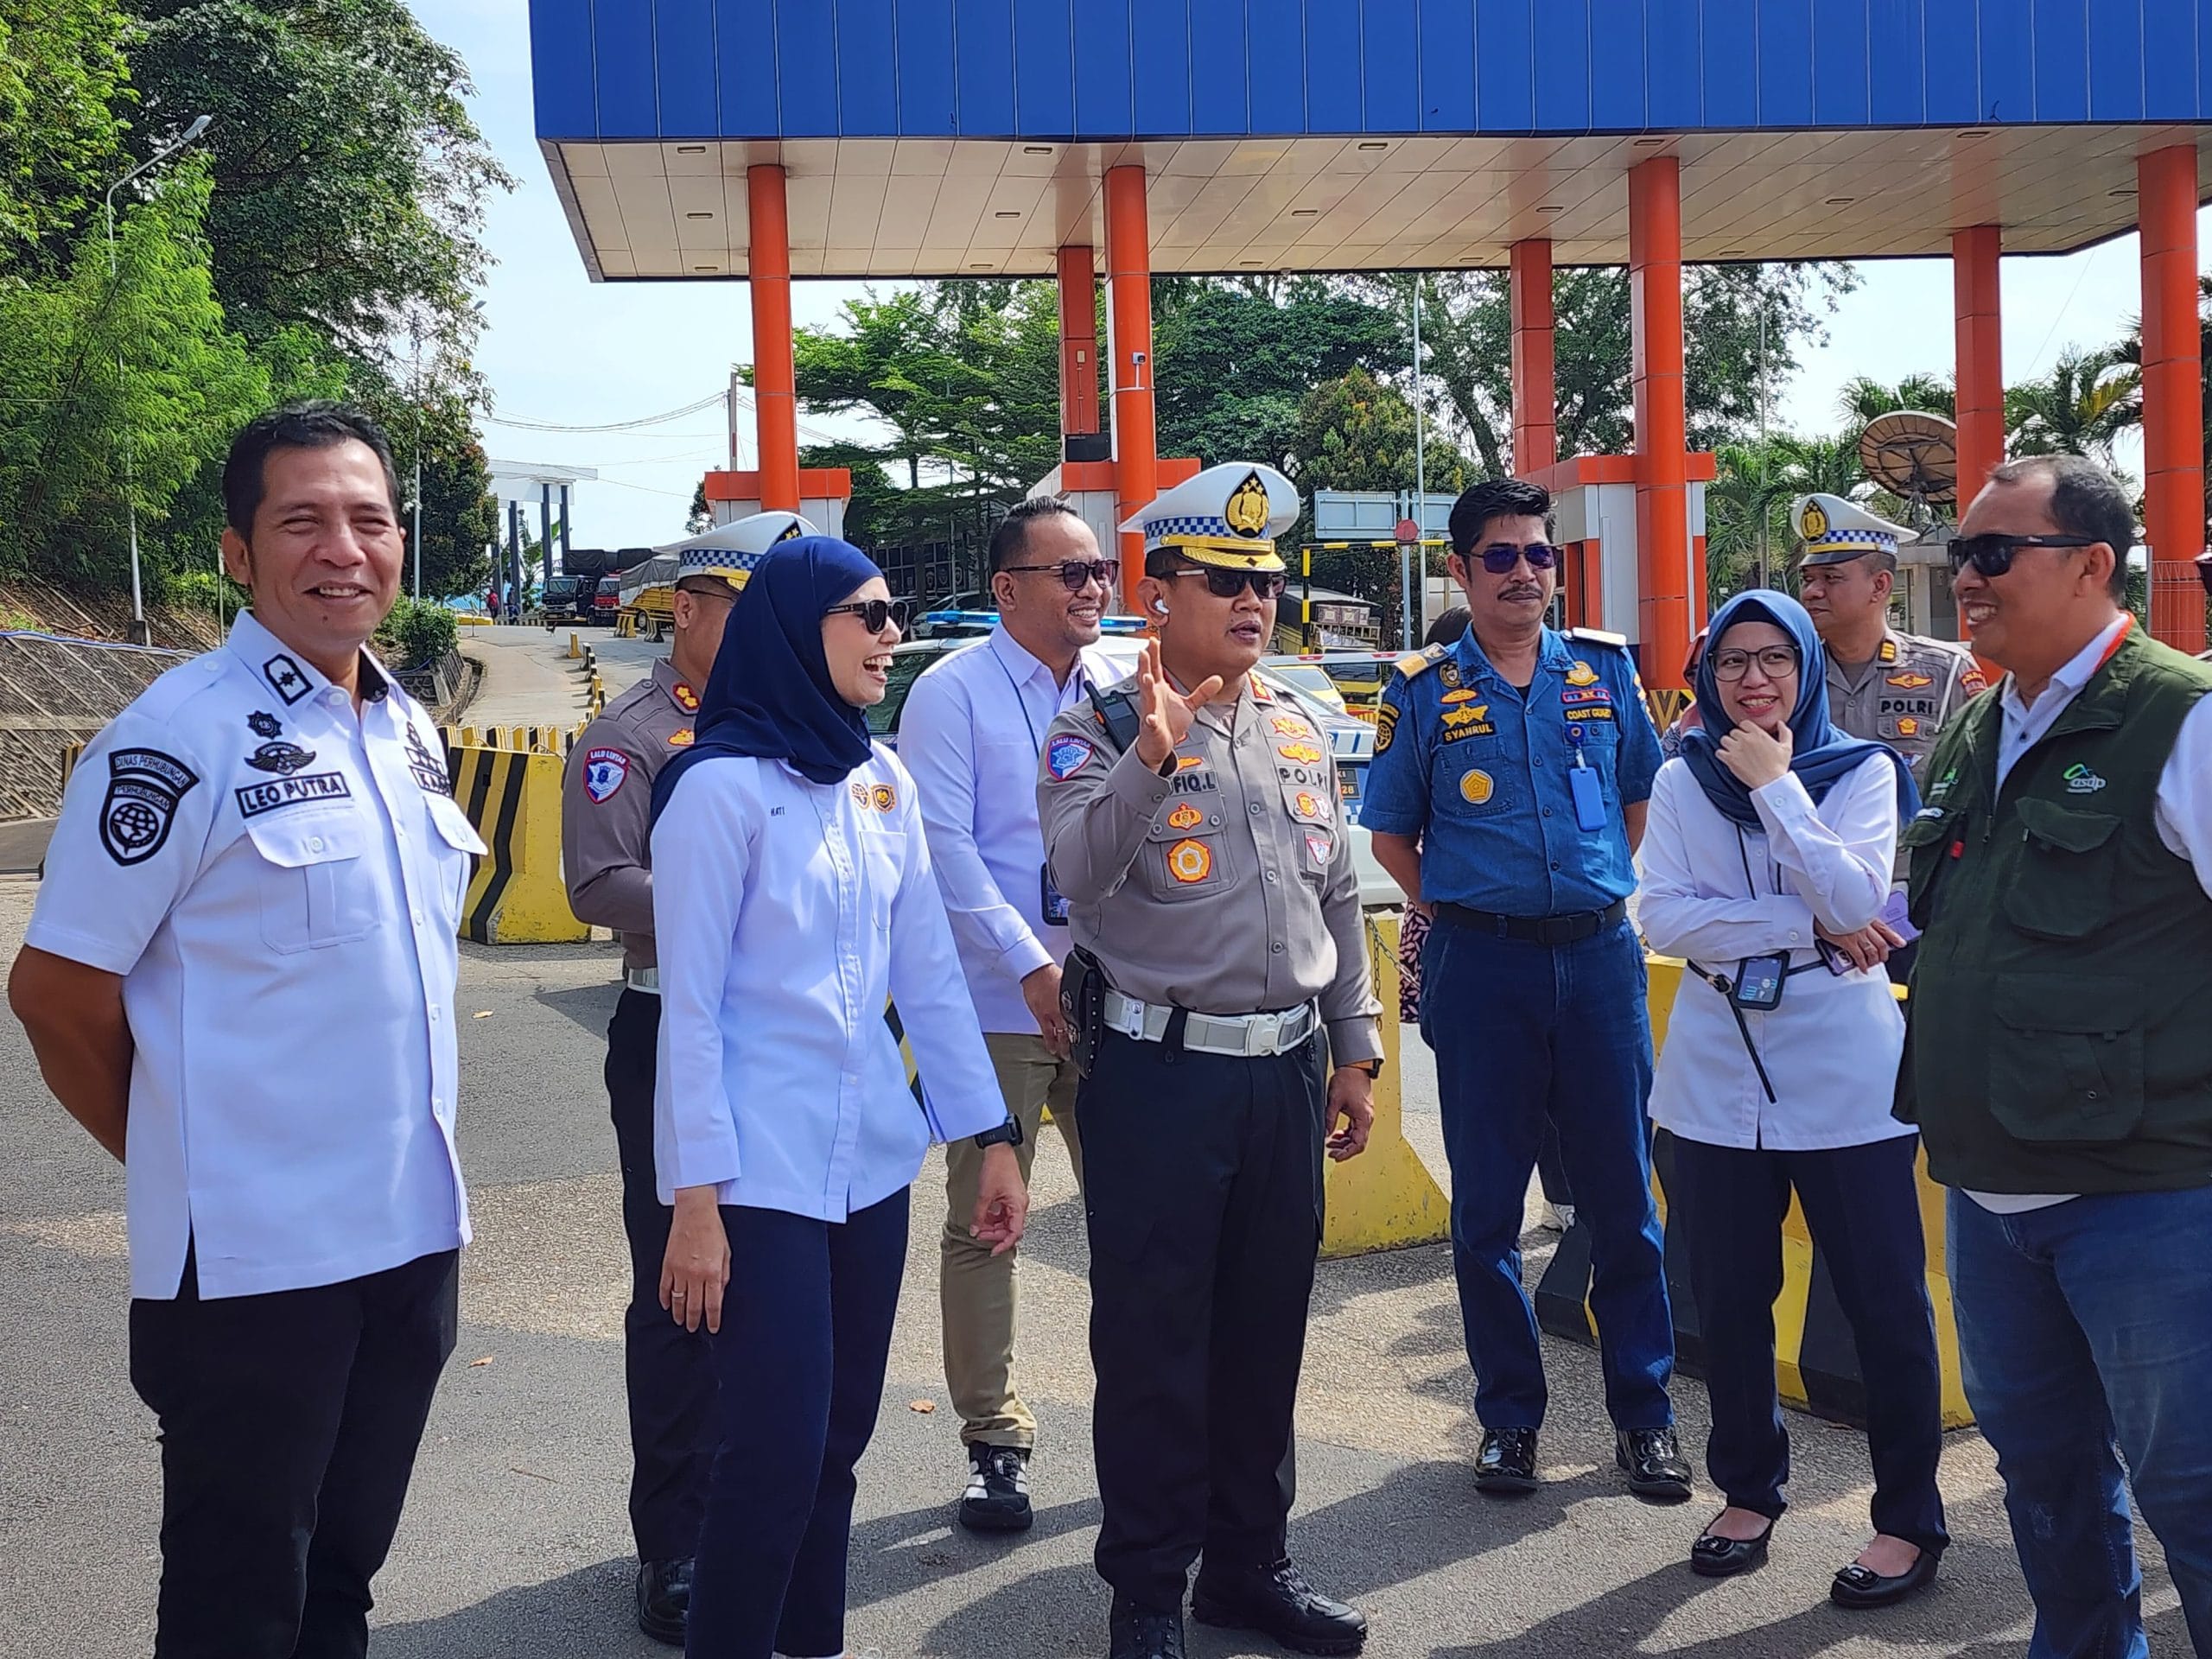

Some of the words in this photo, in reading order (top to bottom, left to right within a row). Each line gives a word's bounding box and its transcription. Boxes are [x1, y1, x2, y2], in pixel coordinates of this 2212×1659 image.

[1567, 709, 1591, 720] COAST
[1881, 700, 1933, 715] POLRI
[1445, 723, 1493, 742] SYAHRUL
[116, 755, 138, 768] DINAS
[1279, 767, 1329, 792] POLRI
[2069, 774, 2107, 791] asdp
[245, 785, 281, 810] LEO
[283, 776, 342, 799] PUTRA
